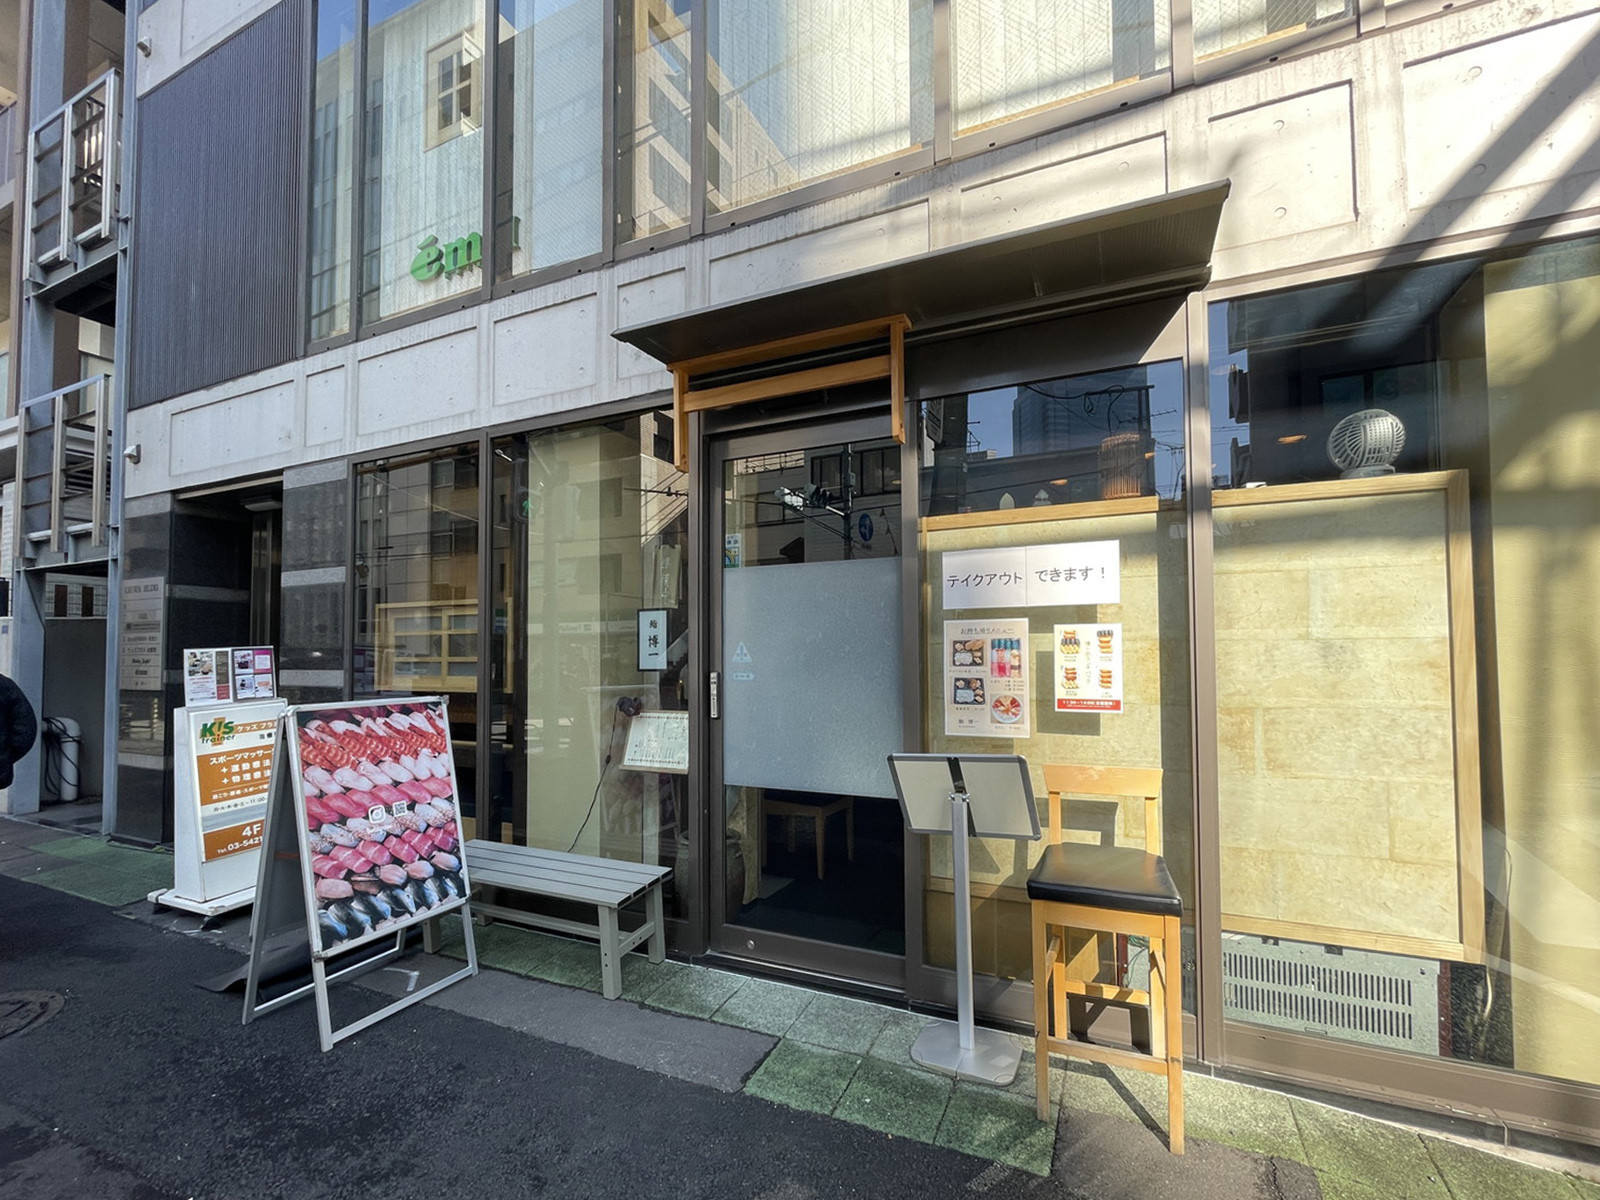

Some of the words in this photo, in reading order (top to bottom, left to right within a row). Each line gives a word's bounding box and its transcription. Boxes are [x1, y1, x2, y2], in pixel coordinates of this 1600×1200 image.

[947, 571, 1023, 588] テイクアウト
[242, 824, 261, 836] 4F
